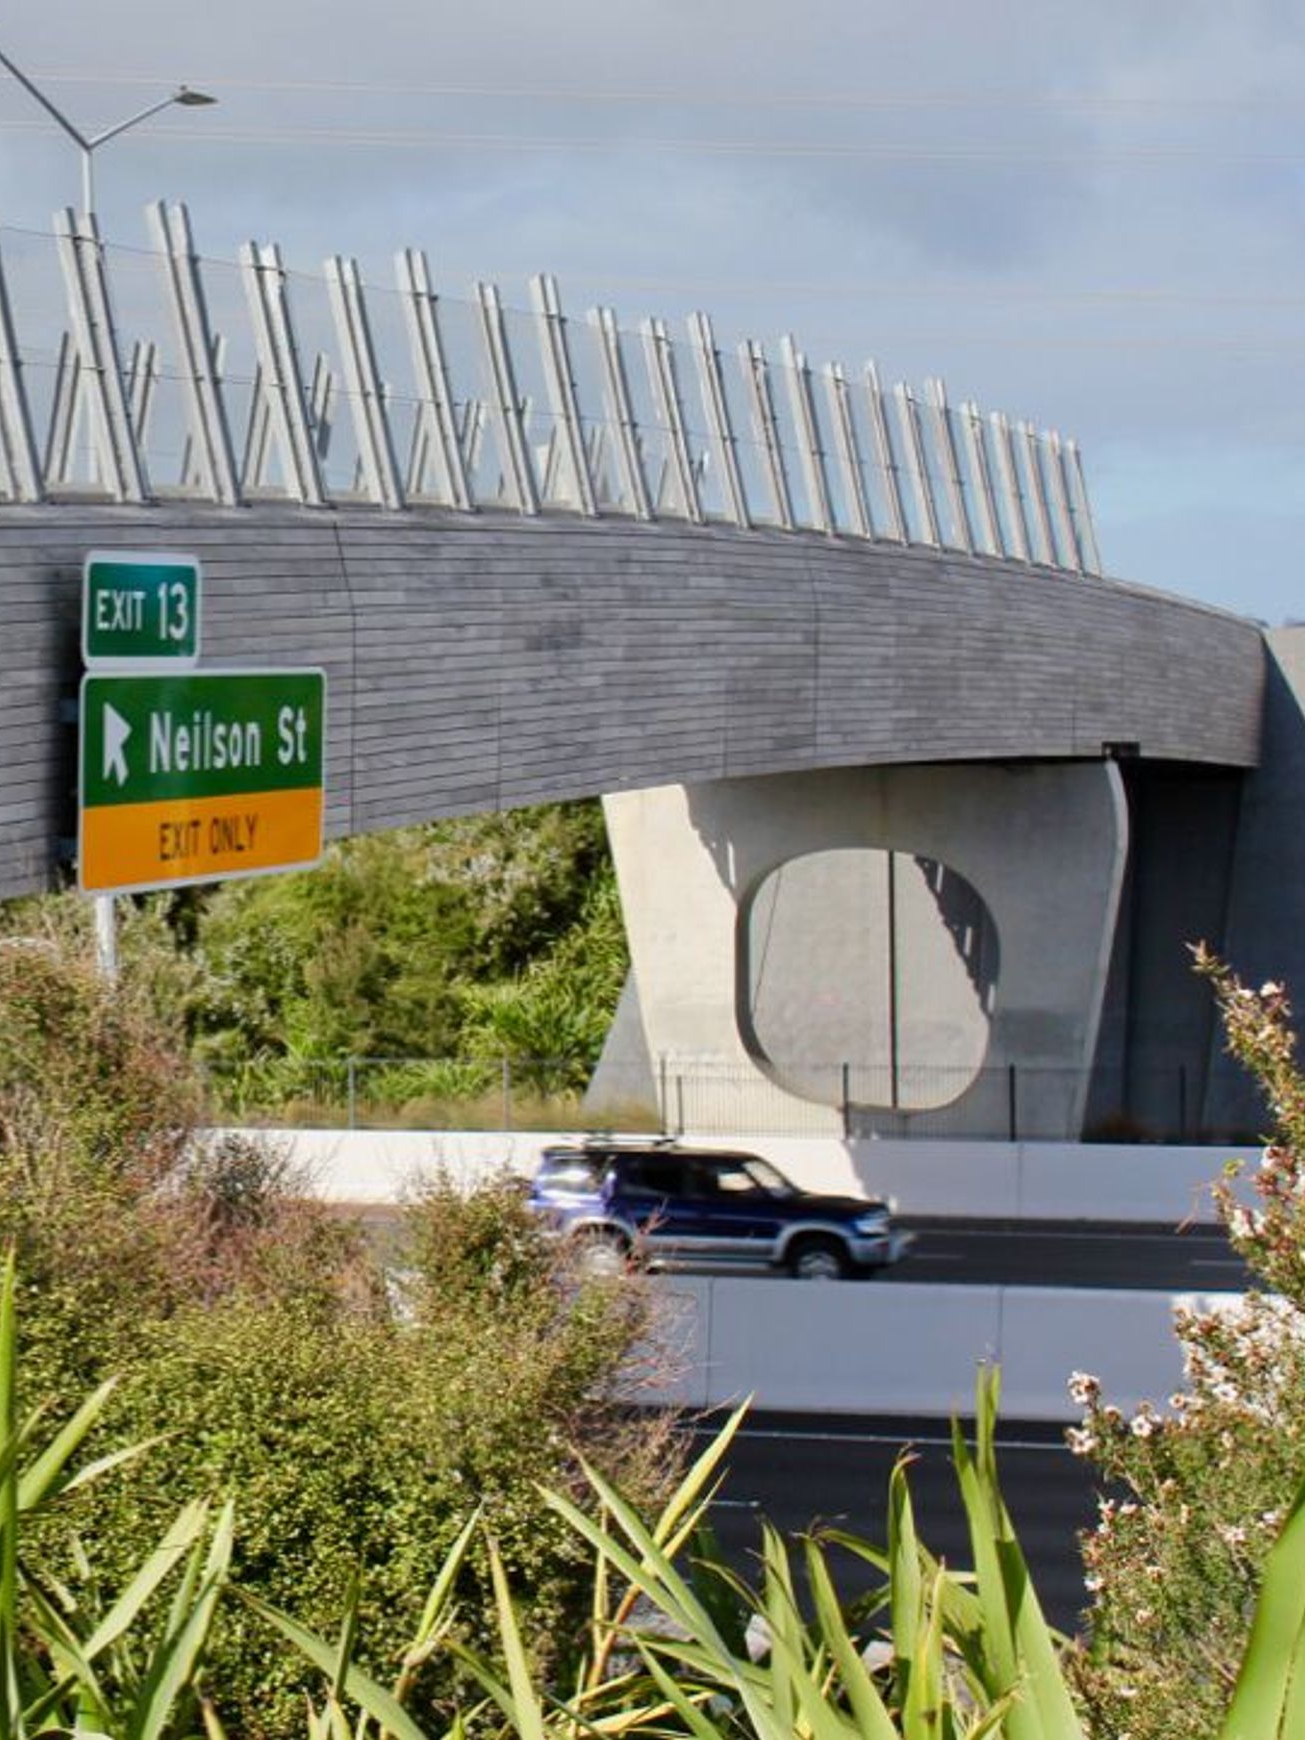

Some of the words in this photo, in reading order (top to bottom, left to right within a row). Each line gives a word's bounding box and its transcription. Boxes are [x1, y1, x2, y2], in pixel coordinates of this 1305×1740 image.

[96, 589, 145, 631] EXIT
[157, 582, 189, 641] 13
[149, 711, 261, 774] Neilson
[277, 705, 308, 765] St
[159, 818, 202, 861] EXIT
[210, 814, 259, 855] ONLY
